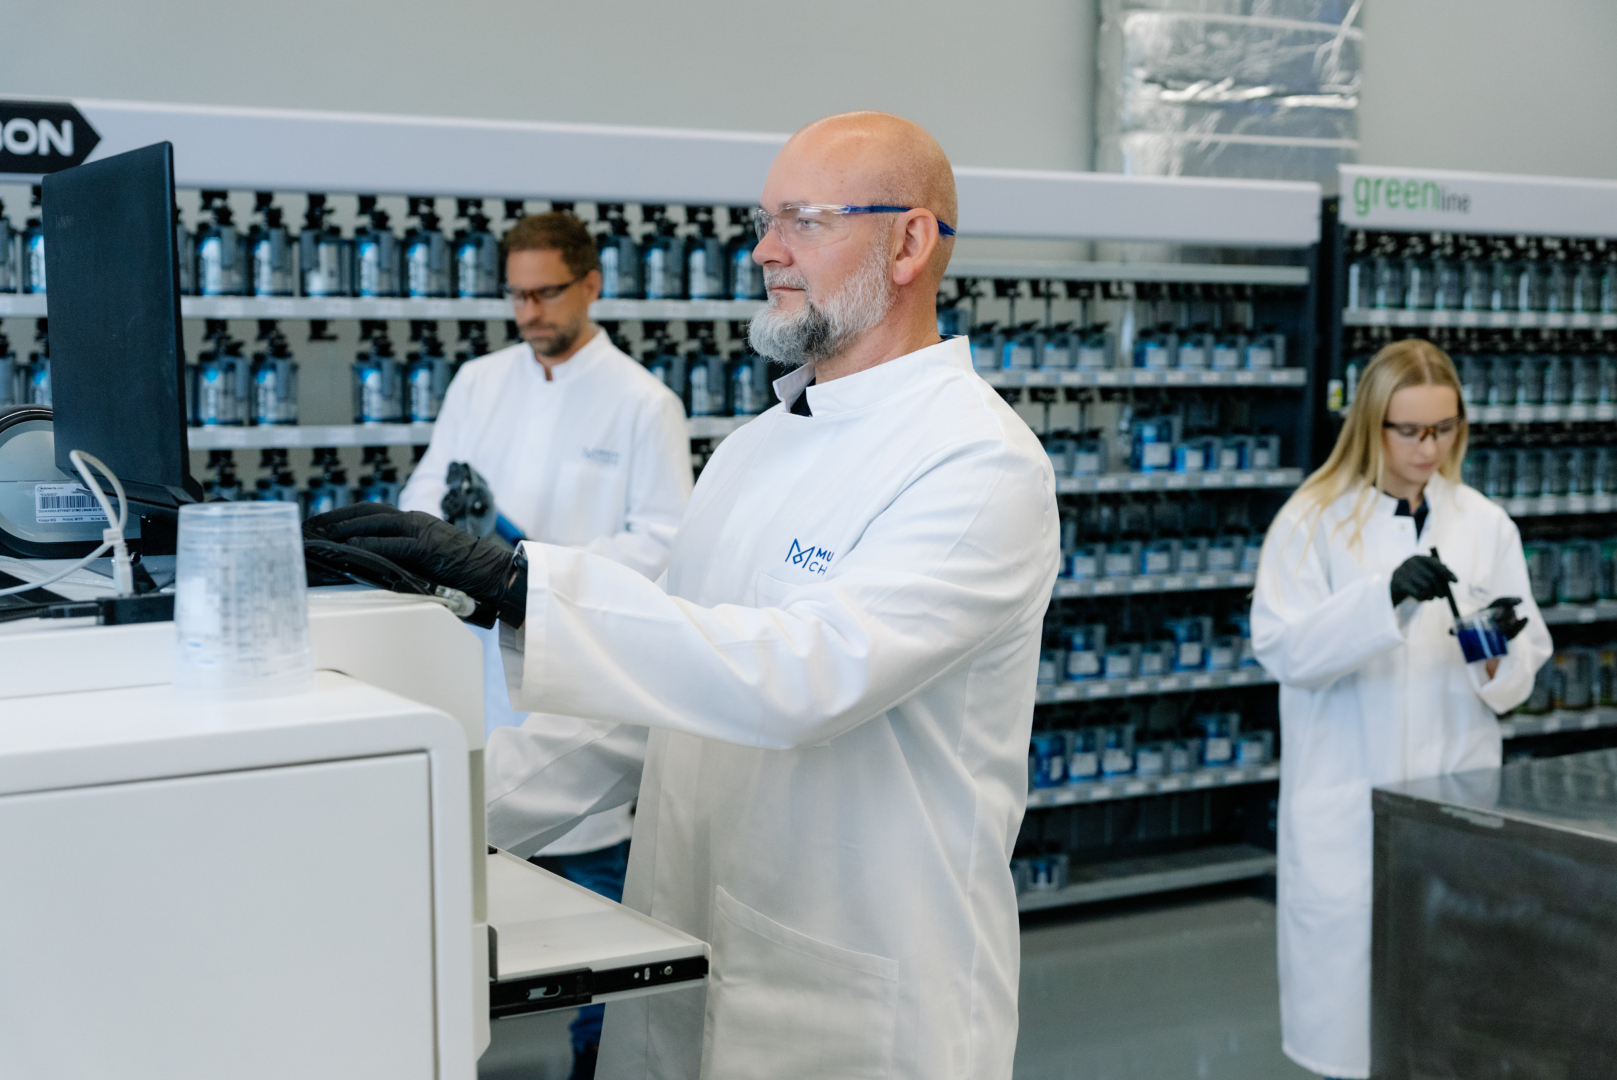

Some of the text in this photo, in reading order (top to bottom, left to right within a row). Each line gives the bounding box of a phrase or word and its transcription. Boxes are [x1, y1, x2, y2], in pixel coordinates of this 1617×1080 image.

[0, 117, 74, 157] ON
[816, 548, 834, 562] MU
[809, 561, 828, 575] CH
